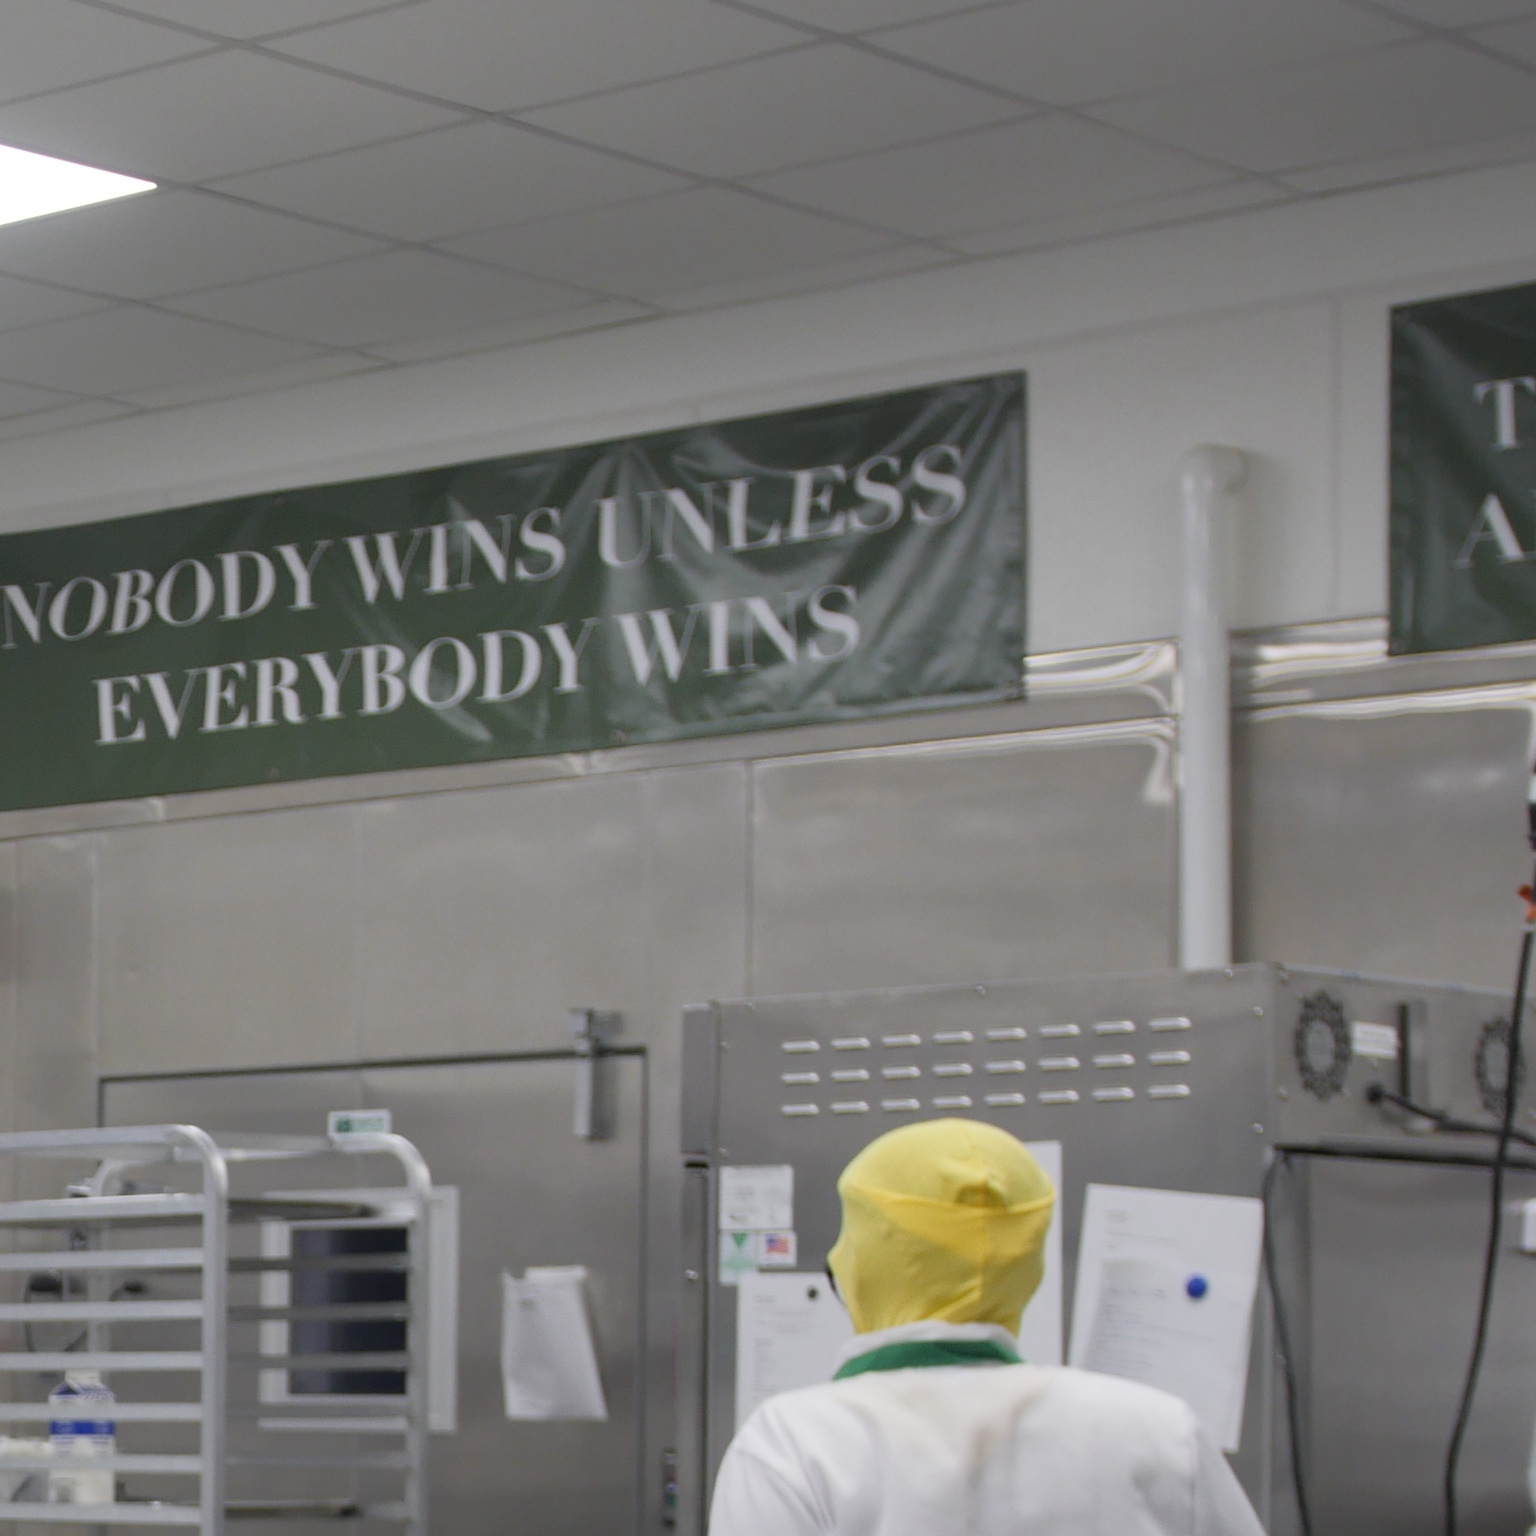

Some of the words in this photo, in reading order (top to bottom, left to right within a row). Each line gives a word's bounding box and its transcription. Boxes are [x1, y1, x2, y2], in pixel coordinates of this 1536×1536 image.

[0, 539, 329, 650] NOBODY
[346, 508, 566, 603] WINS
[597, 443, 968, 570] UNLESS
[94, 617, 595, 745] EVERYBODY
[615, 585, 861, 687] WINS
